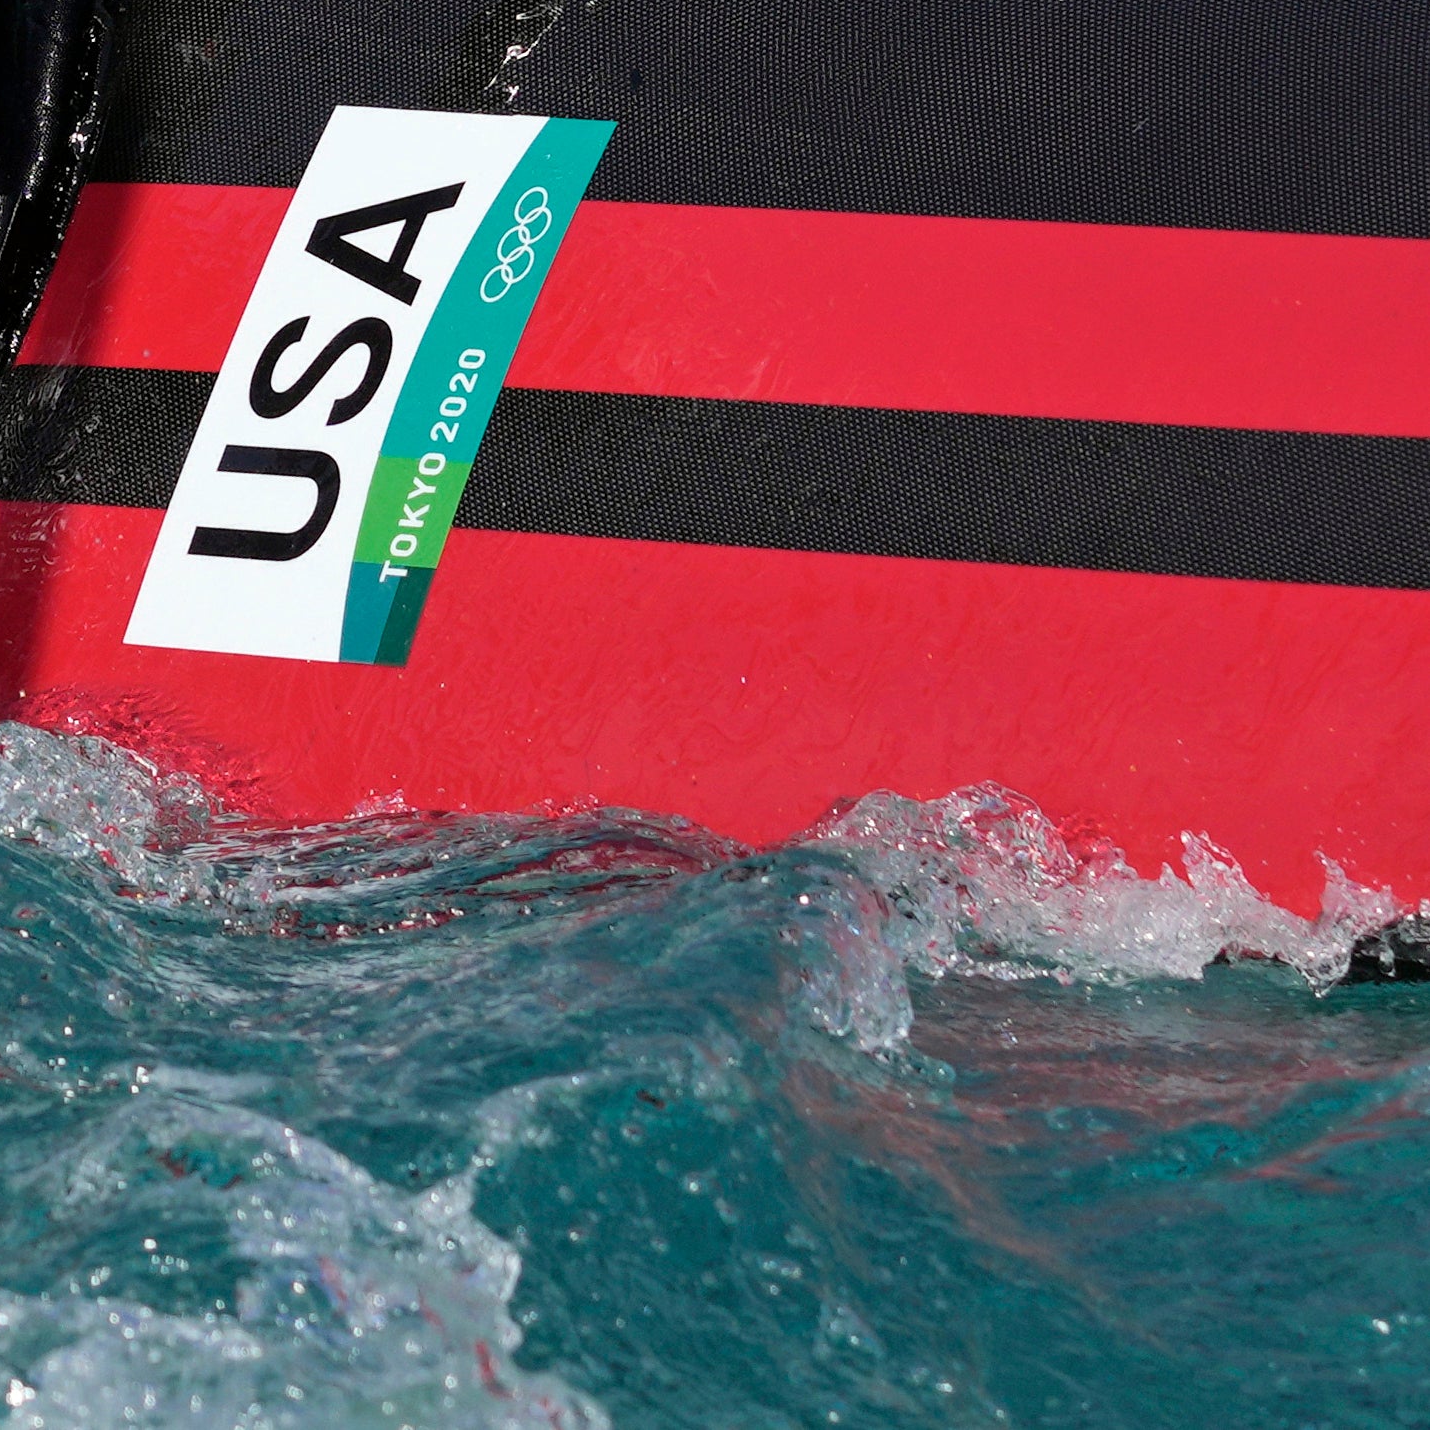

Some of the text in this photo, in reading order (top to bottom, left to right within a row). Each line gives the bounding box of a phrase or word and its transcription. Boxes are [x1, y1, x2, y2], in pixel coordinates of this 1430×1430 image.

[187, 181, 466, 562] USA
[378, 348, 486, 583] TOKYO 2020
